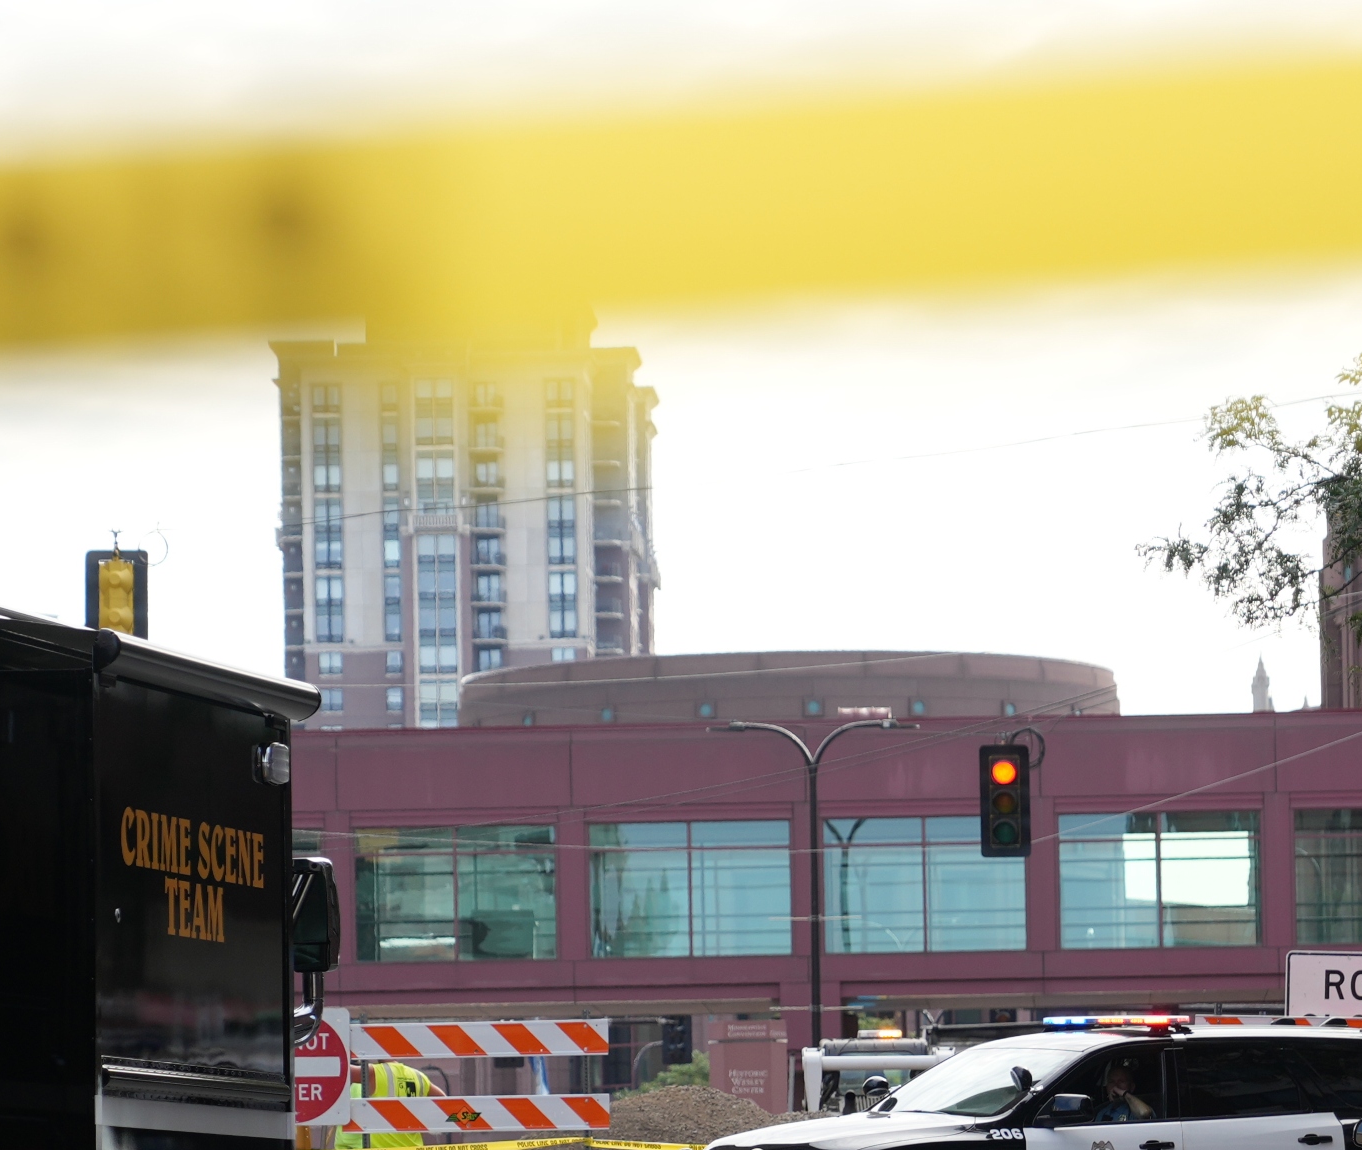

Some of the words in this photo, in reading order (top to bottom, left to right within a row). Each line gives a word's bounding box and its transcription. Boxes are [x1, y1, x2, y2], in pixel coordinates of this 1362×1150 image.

[120, 806, 191, 876] CRIME
[197, 821, 264, 889] SCENE
[164, 876, 225, 943] TEAM
[298, 1032, 330, 1050] OT
[728, 1069, 768, 1077] HISTORIC
[990, 1128, 1024, 1140] 206
